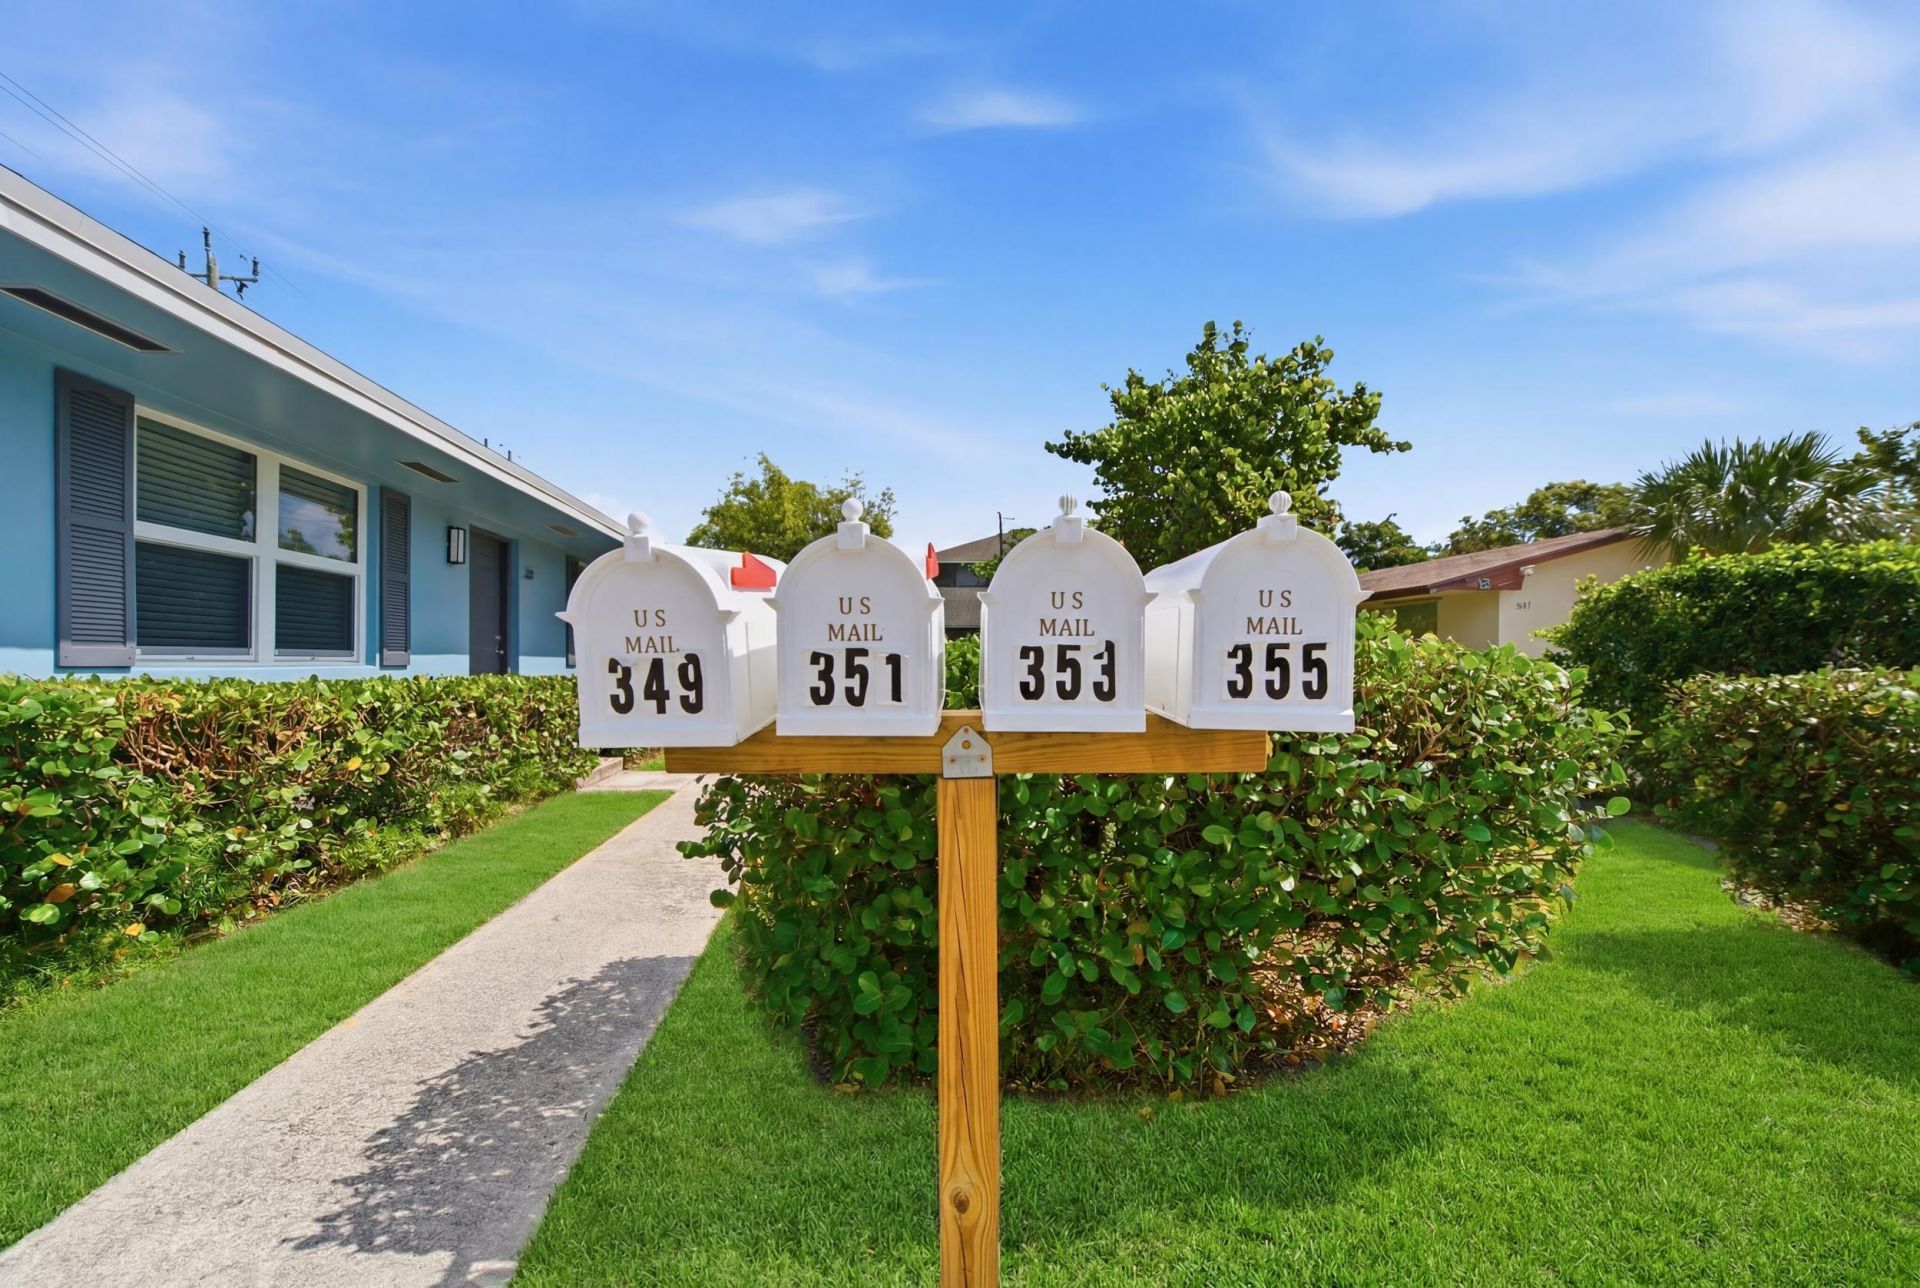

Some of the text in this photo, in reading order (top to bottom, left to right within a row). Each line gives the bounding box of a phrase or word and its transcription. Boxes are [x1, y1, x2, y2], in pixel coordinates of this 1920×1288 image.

[828, 624, 883, 642] MAIL
[1040, 619, 1095, 637] MAIL
[1247, 617, 1303, 635] MAIL
[625, 636, 680, 654] MAIL
[608, 653, 703, 714] 349
[810, 648, 902, 707] 351
[1020, 640, 1116, 702] 353
[1227, 643, 1328, 700] 355
